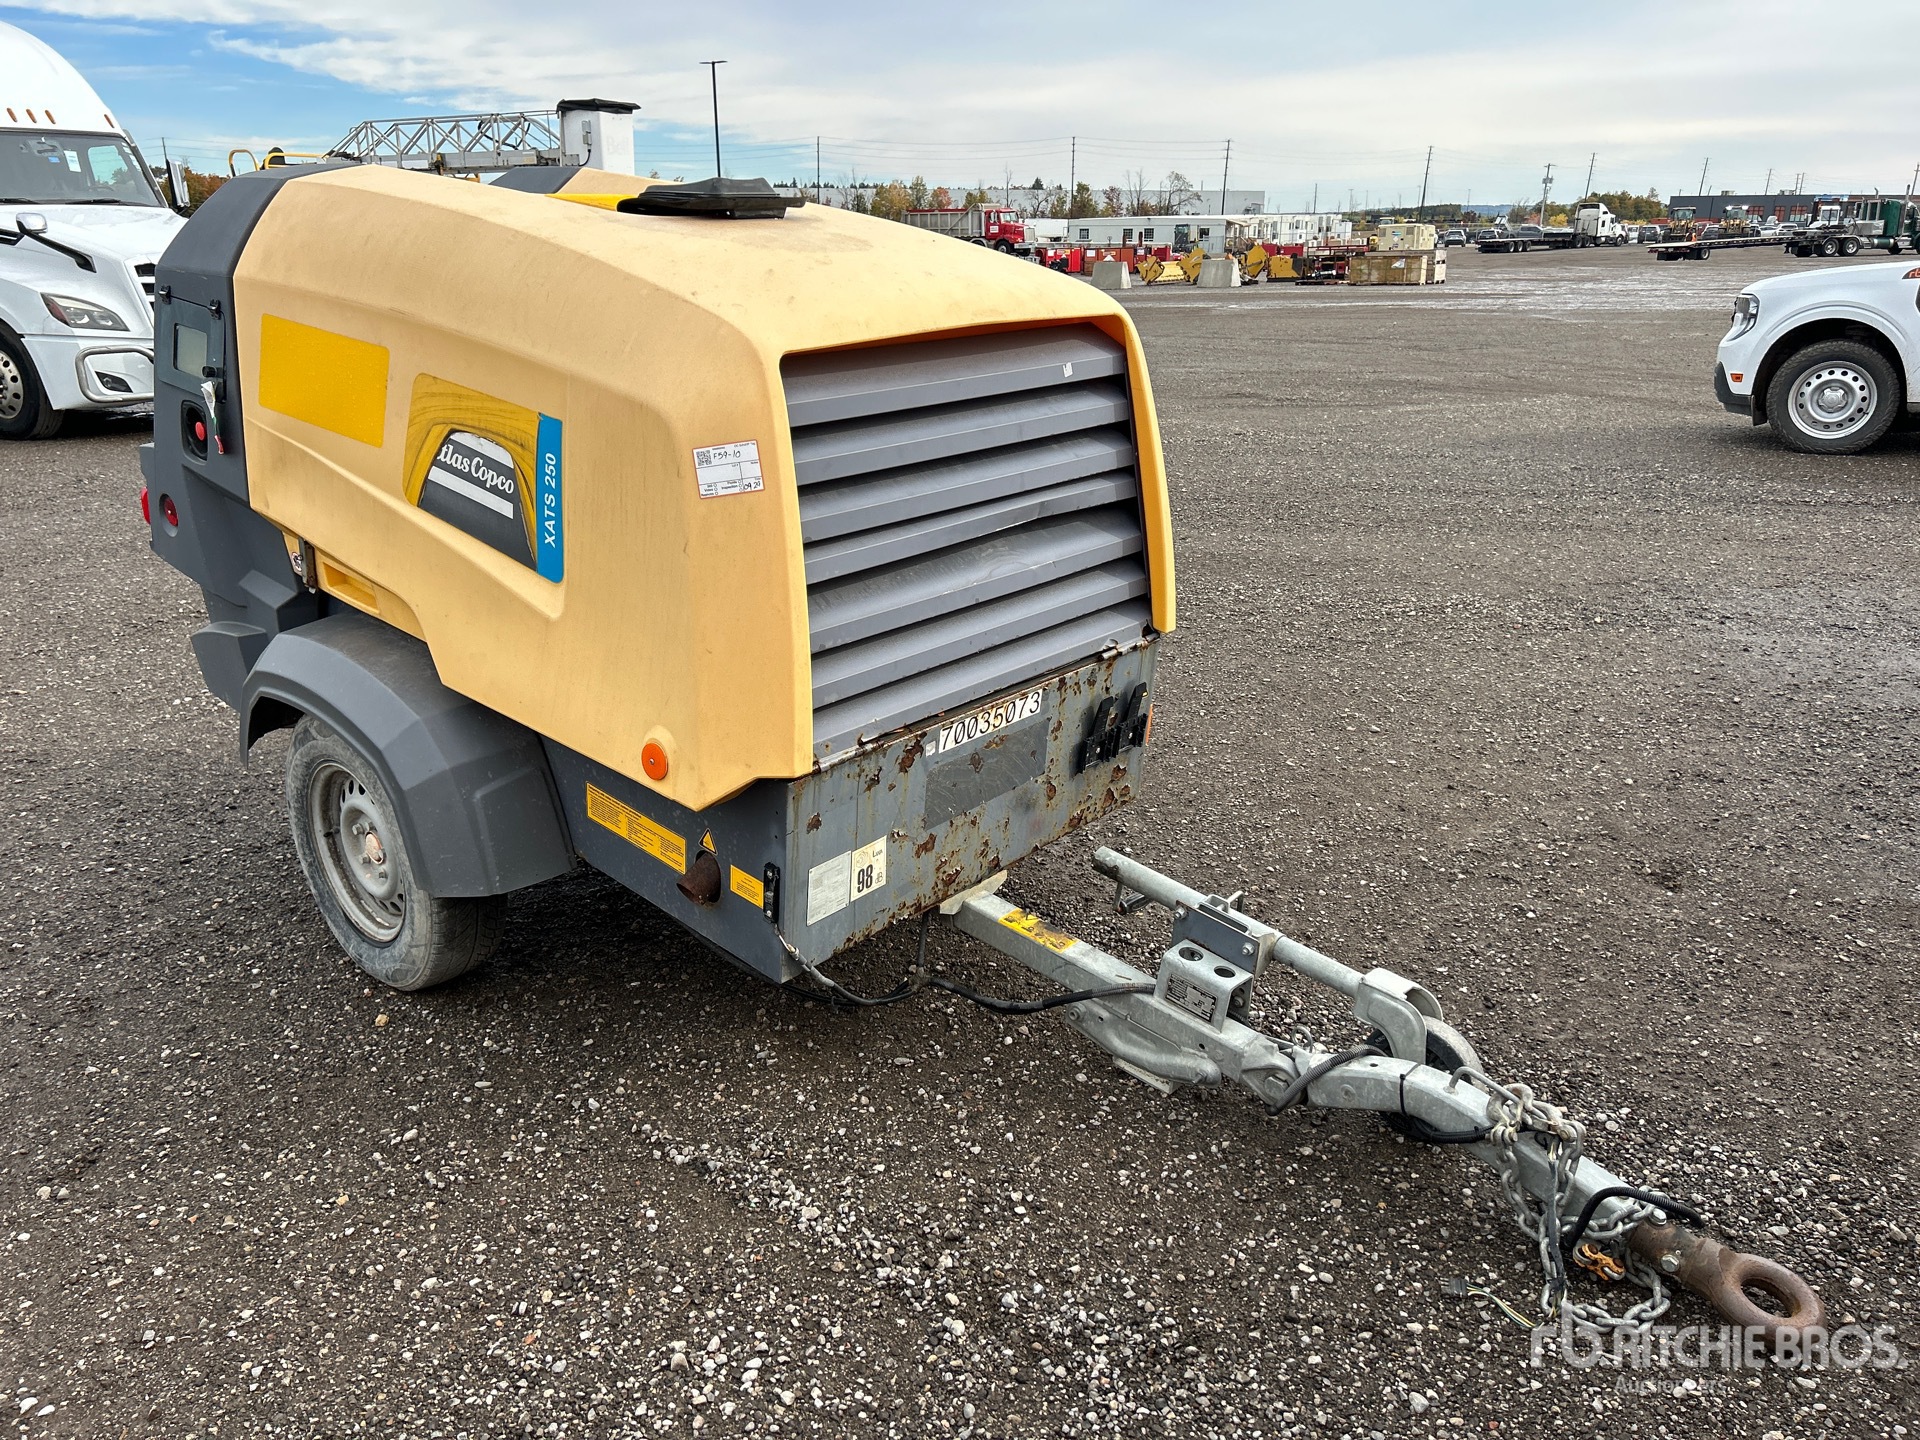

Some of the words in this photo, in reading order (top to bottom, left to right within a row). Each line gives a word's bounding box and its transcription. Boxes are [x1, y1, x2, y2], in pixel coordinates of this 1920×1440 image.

[436, 444, 470, 473] tlas
[471, 457, 515, 494] Copco
[545, 453, 557, 489] 250
[713, 450, 741, 459] F59-10
[545, 493, 556, 548] XATS
[942, 691, 1040, 750] 70035073
[857, 864, 873, 893] 98
[875, 871, 884, 884] dB
